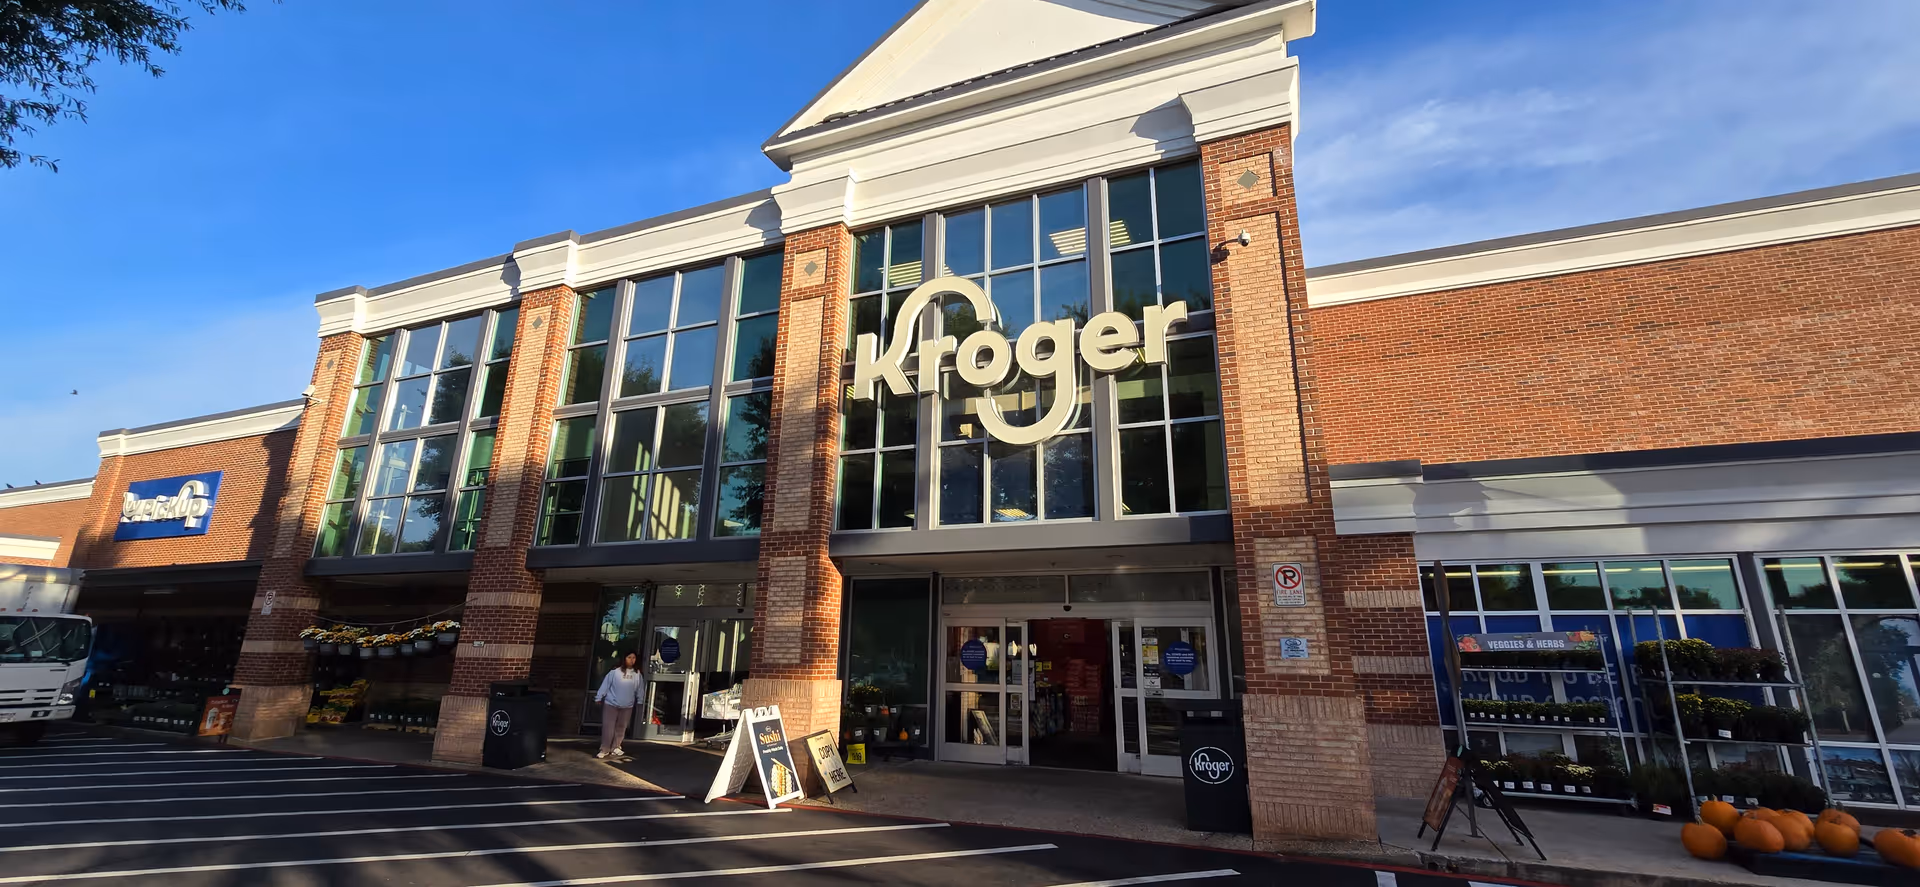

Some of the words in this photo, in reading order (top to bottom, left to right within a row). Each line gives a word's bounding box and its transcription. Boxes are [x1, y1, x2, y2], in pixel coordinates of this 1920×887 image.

[853, 275, 1188, 446] Kroger
[1487, 640, 1525, 649] VEGGIES
[1526, 640, 1534, 649] &
[1536, 639, 1565, 649] HERBS
[492, 714, 509, 733] Kroger
[759, 729, 781, 745] Sushi
[818, 743, 835, 760] COPY
[1194, 752, 1230, 780] Kroger
[828, 767, 847, 784] HERE
